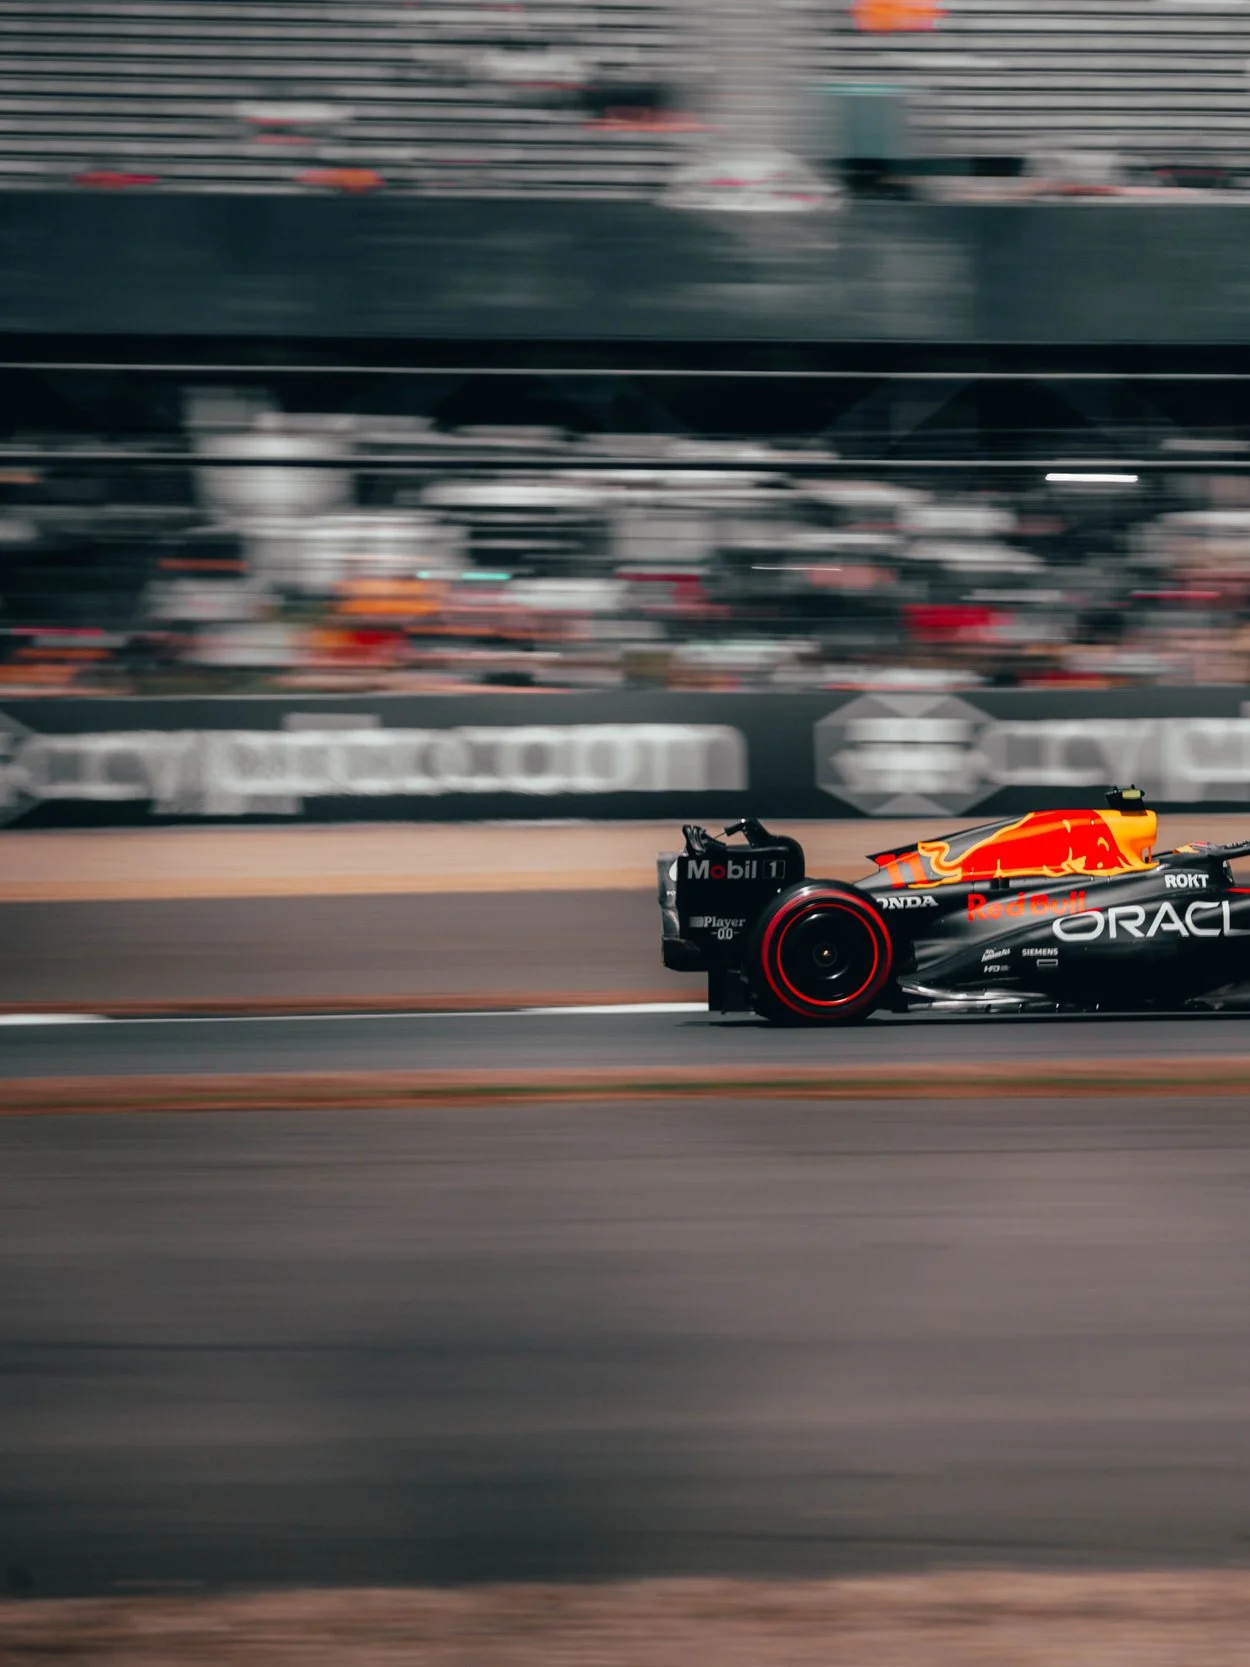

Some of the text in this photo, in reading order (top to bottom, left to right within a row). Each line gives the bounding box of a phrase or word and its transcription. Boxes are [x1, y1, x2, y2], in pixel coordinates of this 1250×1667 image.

[687, 860, 757, 879] Mobil
[875, 852, 929, 889] 11
[1164, 874, 1209, 888] ROKT
[875, 895, 939, 910] ONDA
[967, 890, 1087, 922] Red Bull
[703, 916, 746, 929] Player
[1021, 947, 1059, 957] SIEMENS
